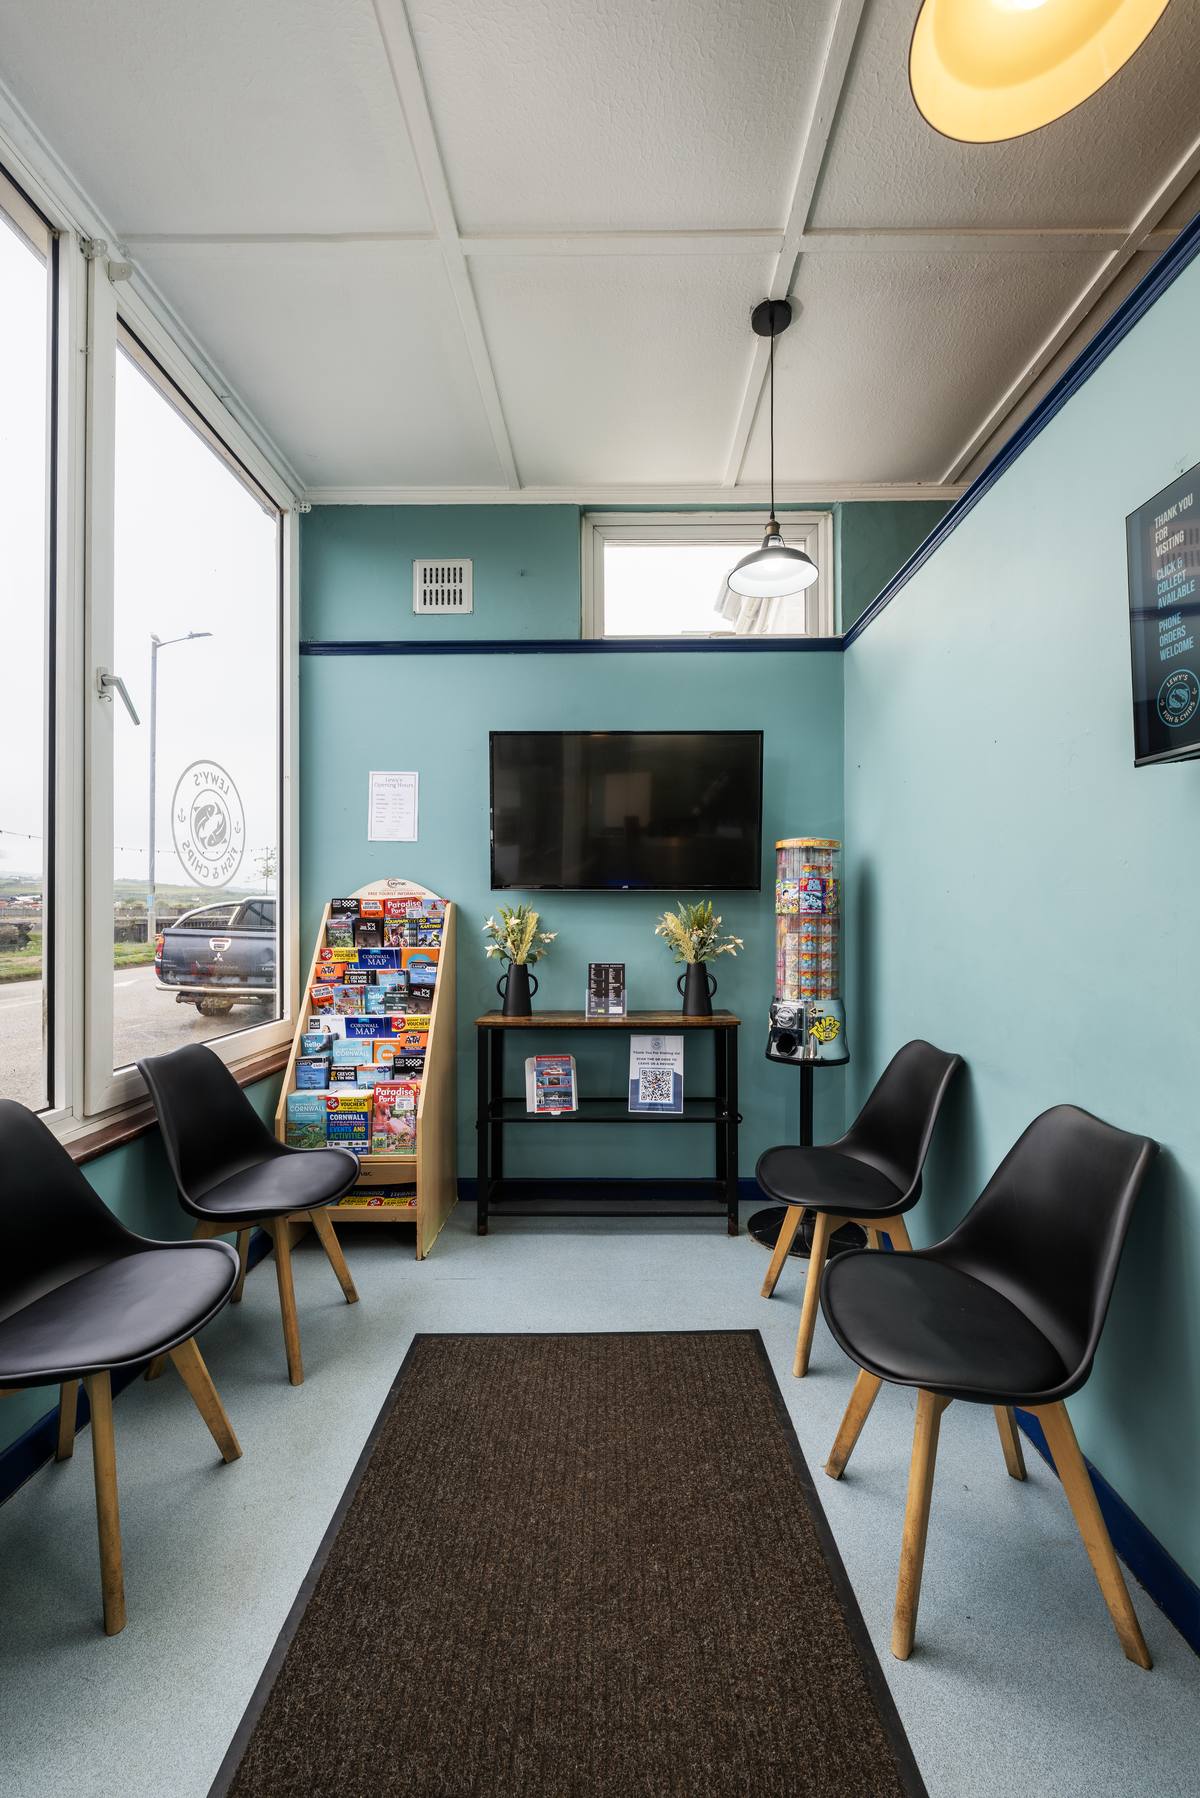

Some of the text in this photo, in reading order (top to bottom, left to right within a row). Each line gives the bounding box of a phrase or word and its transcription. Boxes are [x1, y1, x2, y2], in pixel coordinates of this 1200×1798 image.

[1155, 493, 1194, 530] THANK YOU
[1155, 526, 1169, 544] FOR
[1155, 530, 1185, 558] VISITING
[1156, 556, 1185, 581] CLICK &
[1157, 569, 1186, 595] COLLECT
[1158, 579, 1195, 610] AVAILABLE
[1159, 611, 1182, 634] PHONE
[1160, 625, 1186, 647] ORDERS
[1160, 637, 1194, 662] WELCOME
[1166, 674, 1188, 688] LEWY'S
[1162, 710, 1174, 722] FISH
[1179, 701, 1196, 721] CHIPS
[387, 901, 421, 910] Paradise
[367, 958, 387, 966] MAP
[355, 1027, 376, 1035] MAP
[375, 1086, 415, 1097] Paradise
[329, 1113, 366, 1121] CORNWALL
[329, 1132, 367, 1140] ACTIVITIES
